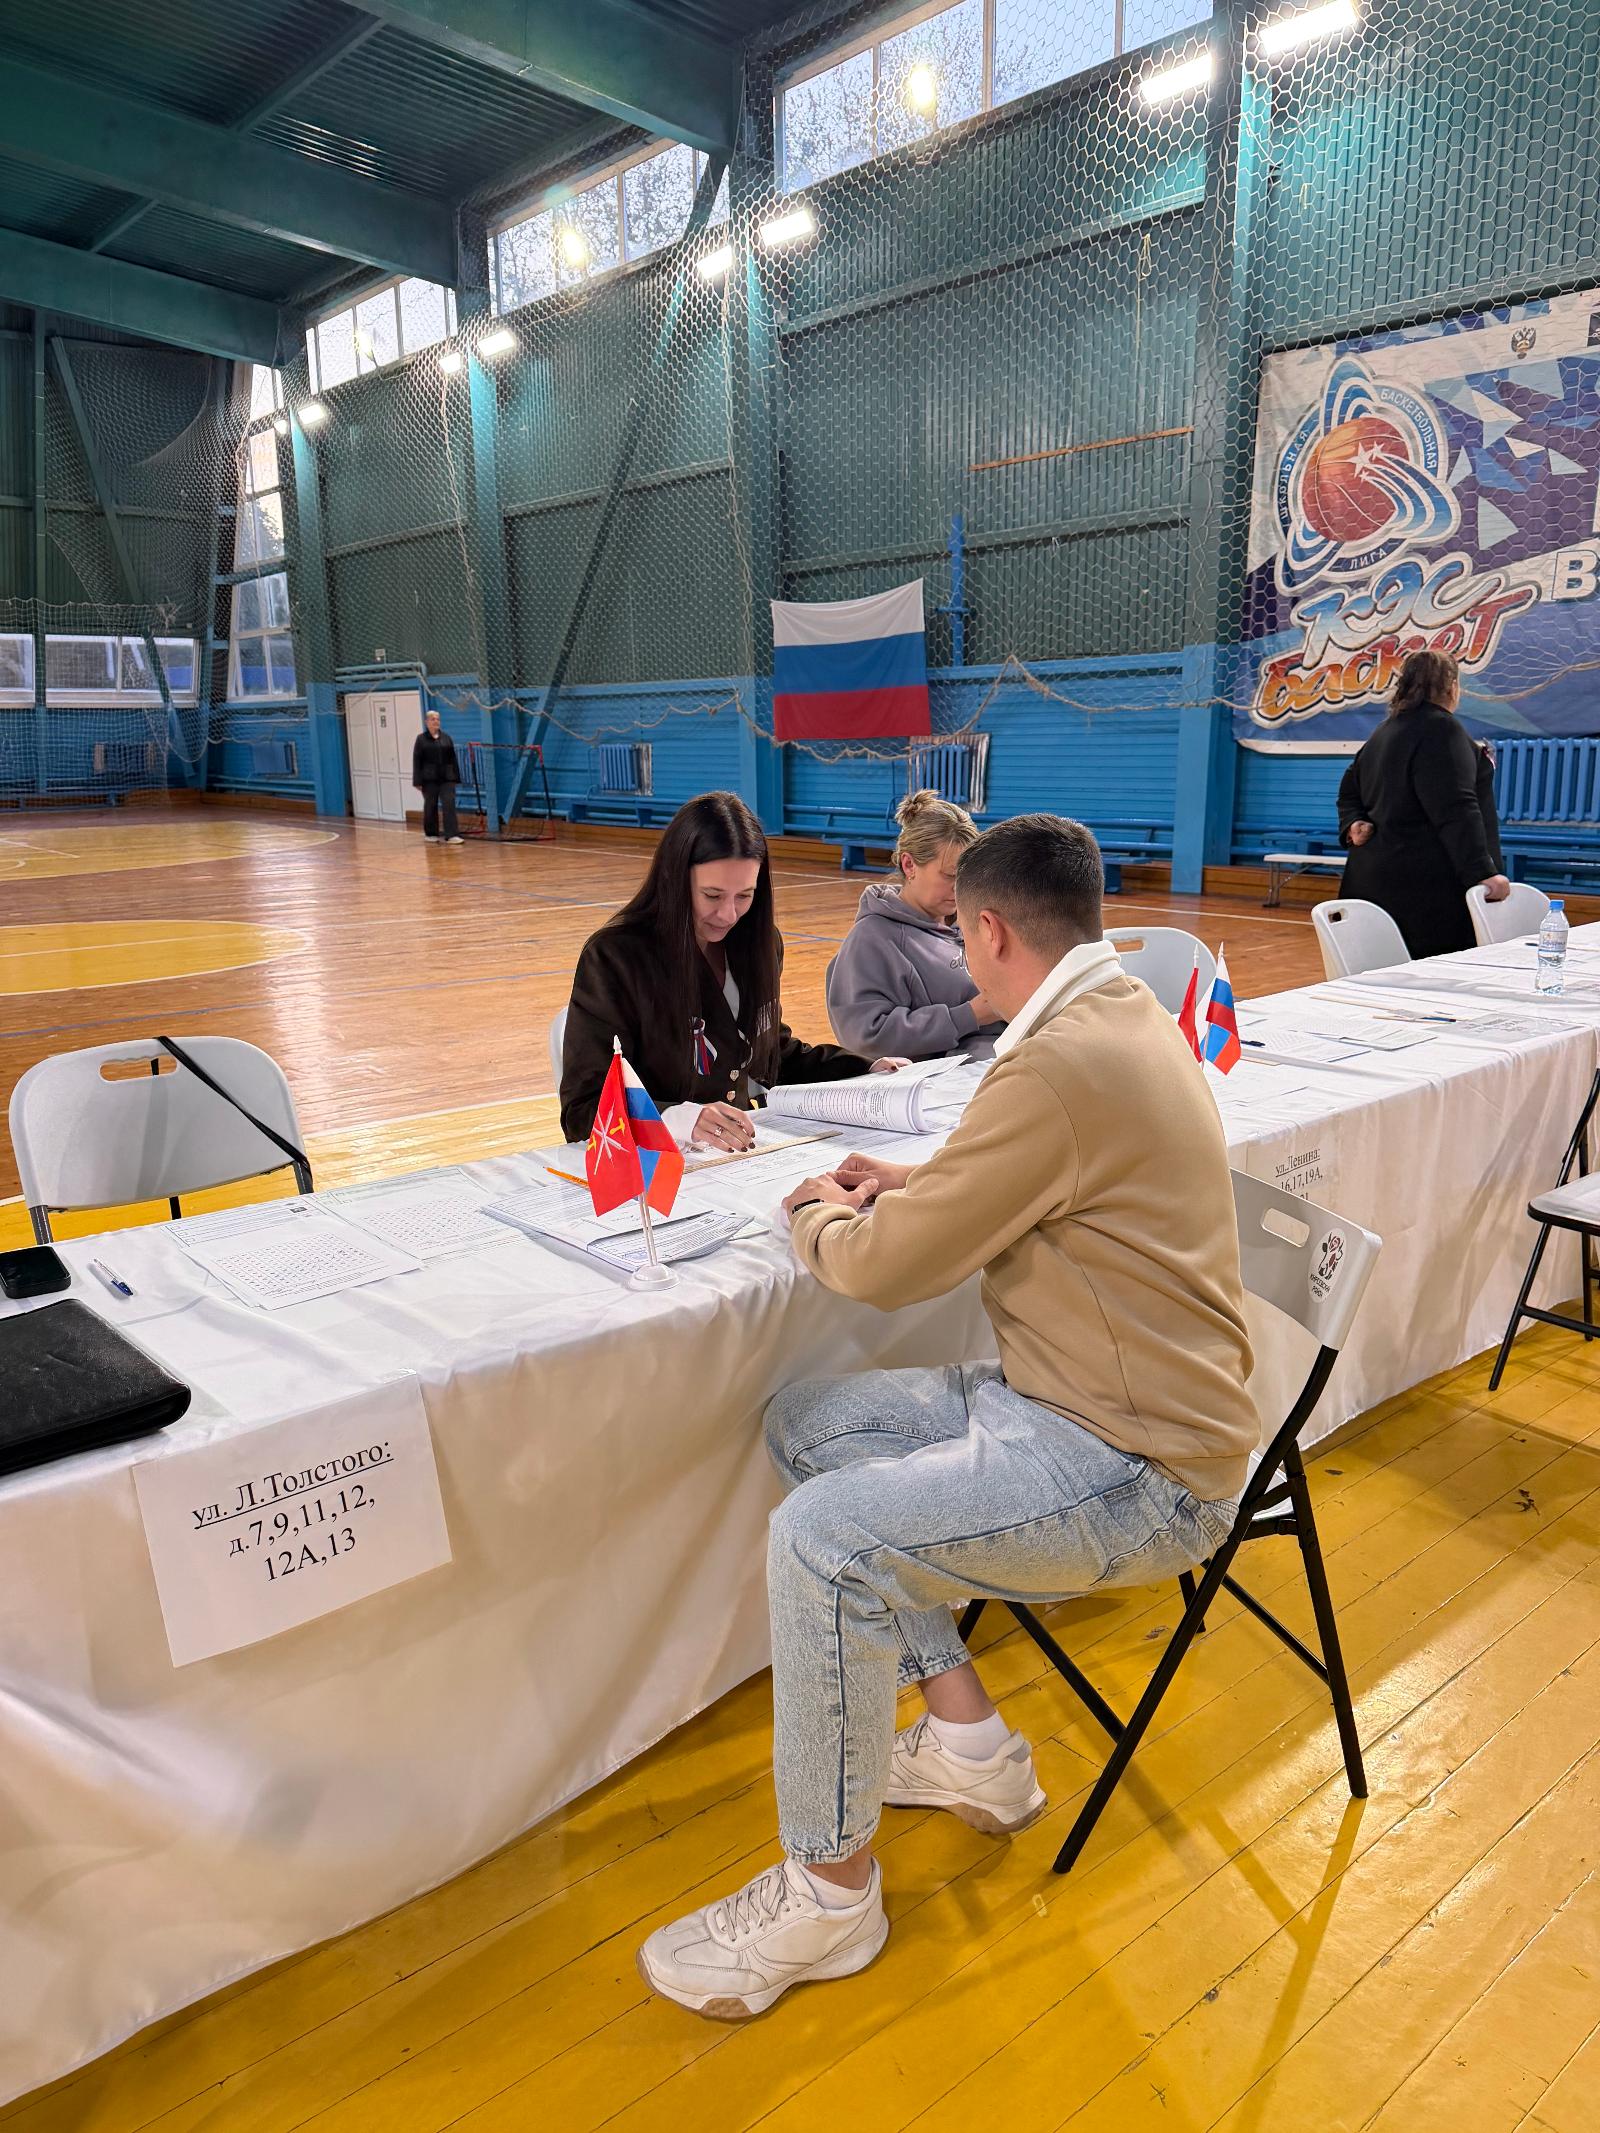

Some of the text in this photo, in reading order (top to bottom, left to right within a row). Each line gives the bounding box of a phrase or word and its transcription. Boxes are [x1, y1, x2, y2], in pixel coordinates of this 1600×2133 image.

[1380, 387, 1437, 470] БАСКЕТБОЛЬНАЯ
[1279, 430, 1309, 520] ШКОЛЬНАЯ
[1349, 548, 1387, 570] ЛИГА
[1552, 550, 1600, 602] В
[192, 1503, 228, 1530] ул.
[264, 1527, 356, 1582] 12А,13
